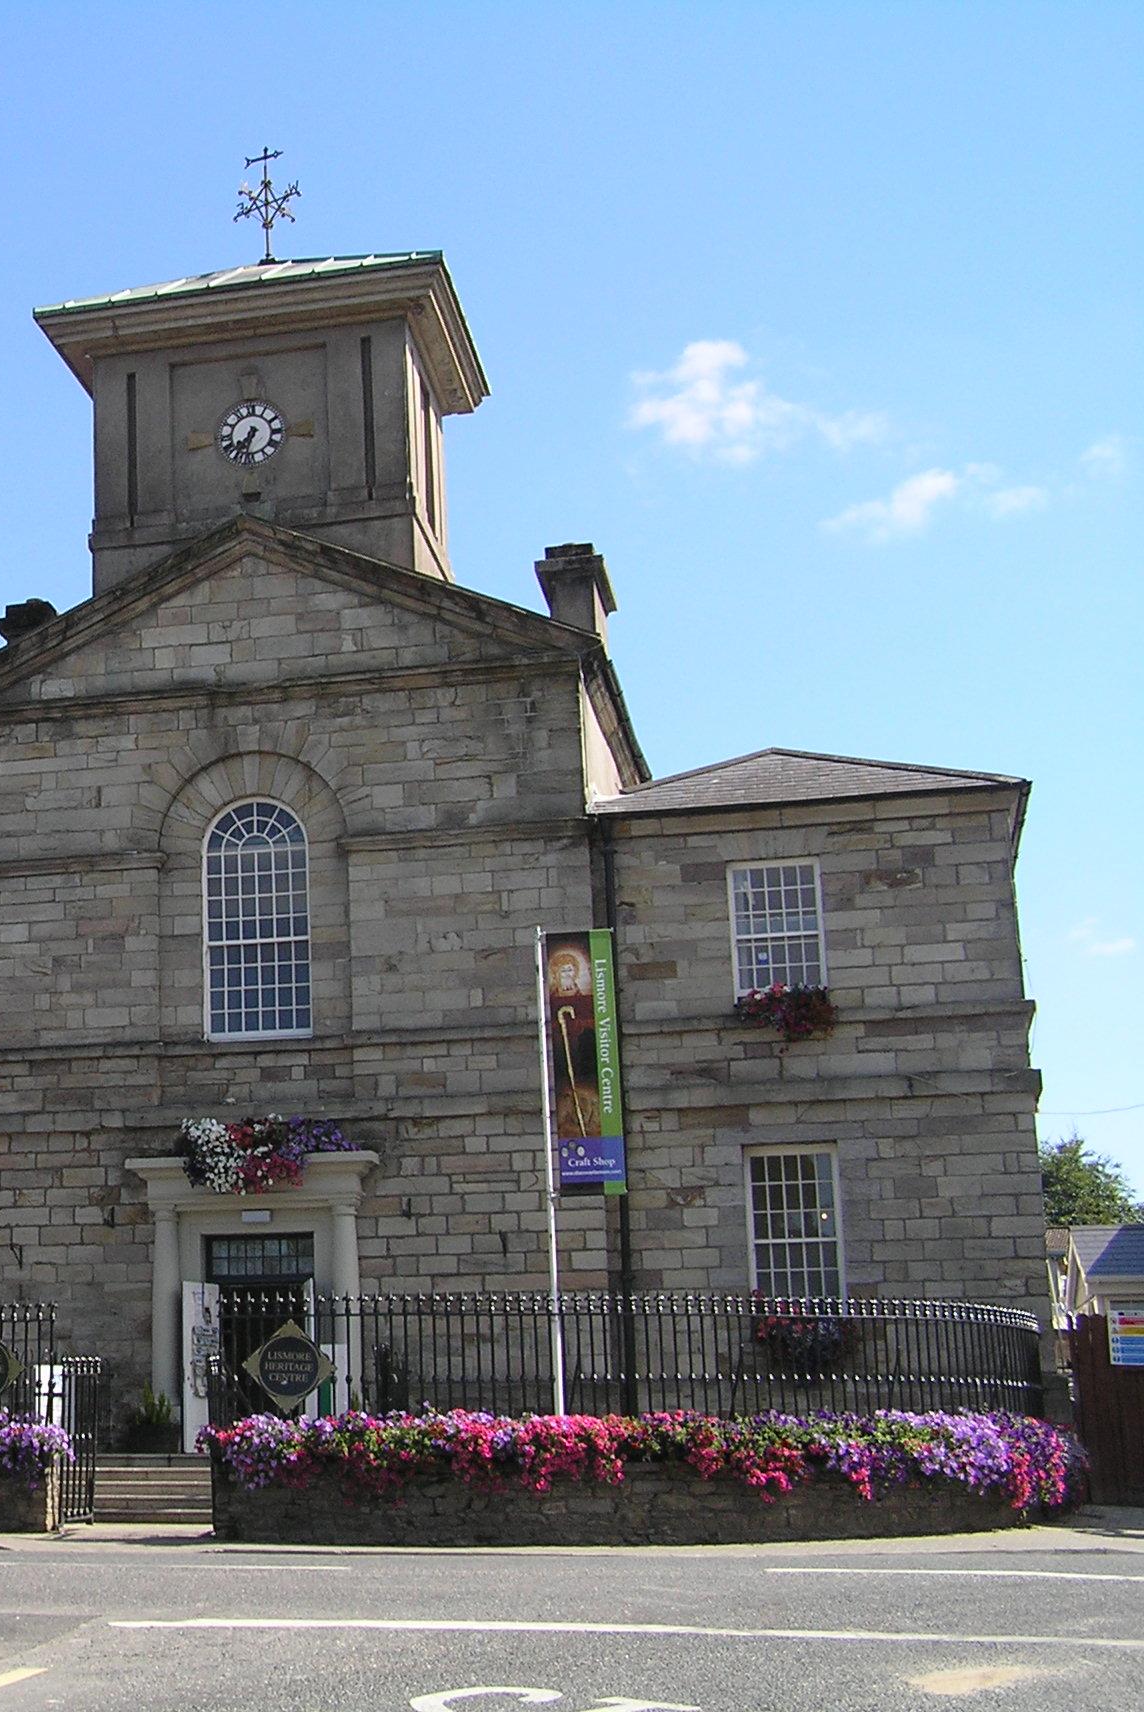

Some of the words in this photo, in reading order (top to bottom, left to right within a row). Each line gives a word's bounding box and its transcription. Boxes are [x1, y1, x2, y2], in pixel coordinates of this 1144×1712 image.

[594, 958, 607, 1013] Lismore
[599, 1017, 611, 1064] Visitor
[601, 1067, 614, 1114] Centre
[568, 1157, 591, 1167] Craft
[593, 1157, 615, 1167] Shop
[267, 1351, 312, 1361] LISMORE
[264, 1361, 313, 1372] HERITAGE
[268, 1372, 309, 1382] CENTRE
